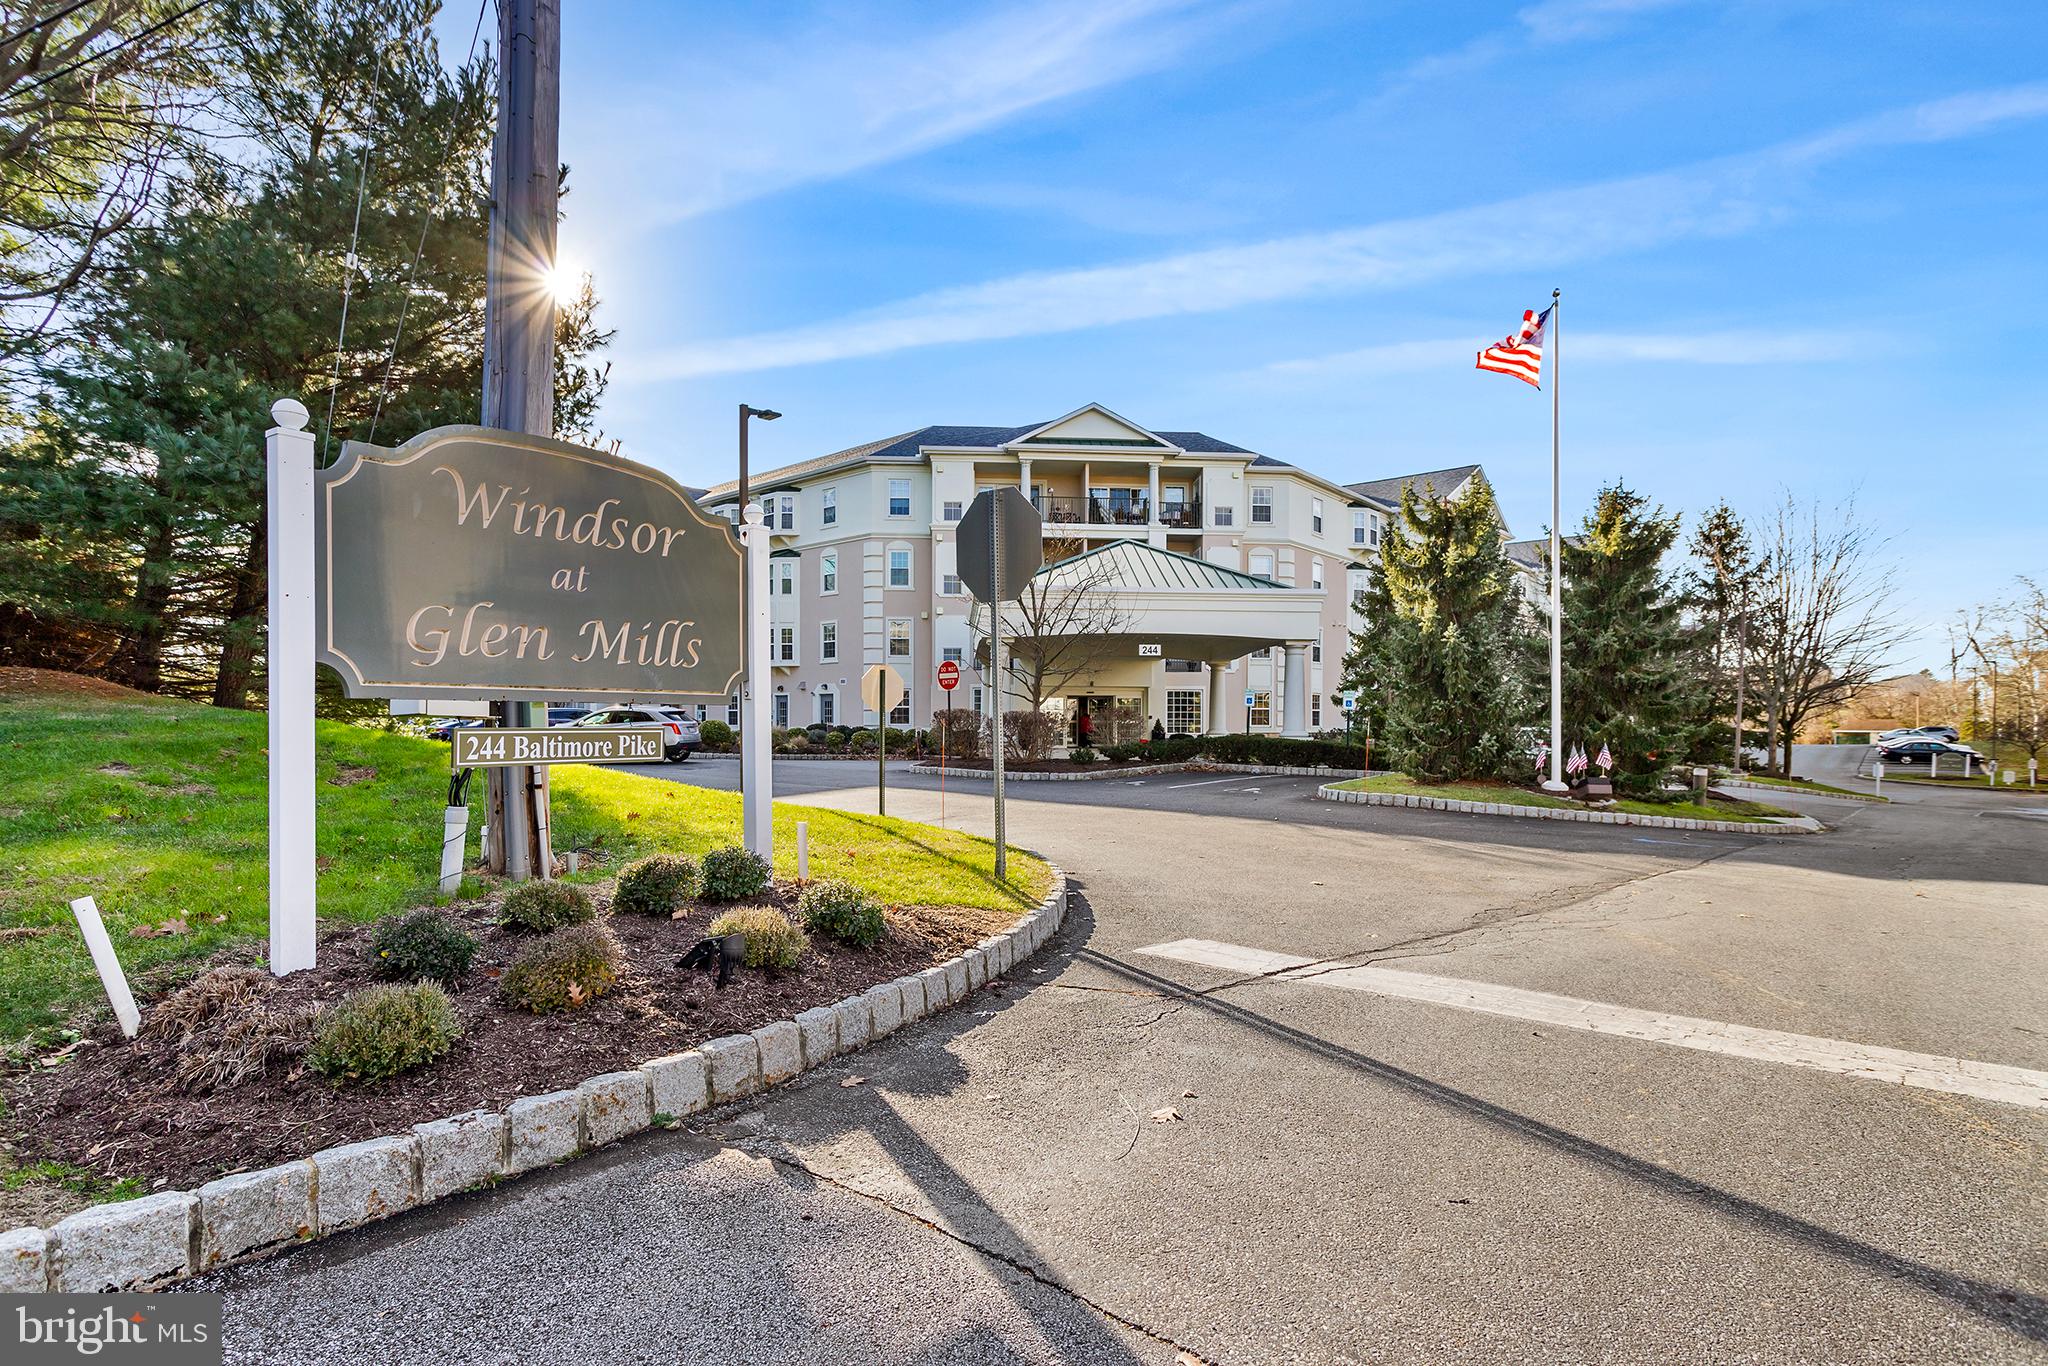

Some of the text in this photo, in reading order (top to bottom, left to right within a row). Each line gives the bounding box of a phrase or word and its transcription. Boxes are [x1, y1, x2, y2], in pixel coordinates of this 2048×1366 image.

[430, 464, 686, 557] Windsor
[550, 565, 591, 593] at
[405, 601, 702, 669] Glen Mills
[1142, 646, 1158, 654] 244
[466, 734, 657, 760] 244 Baltimore Pike
